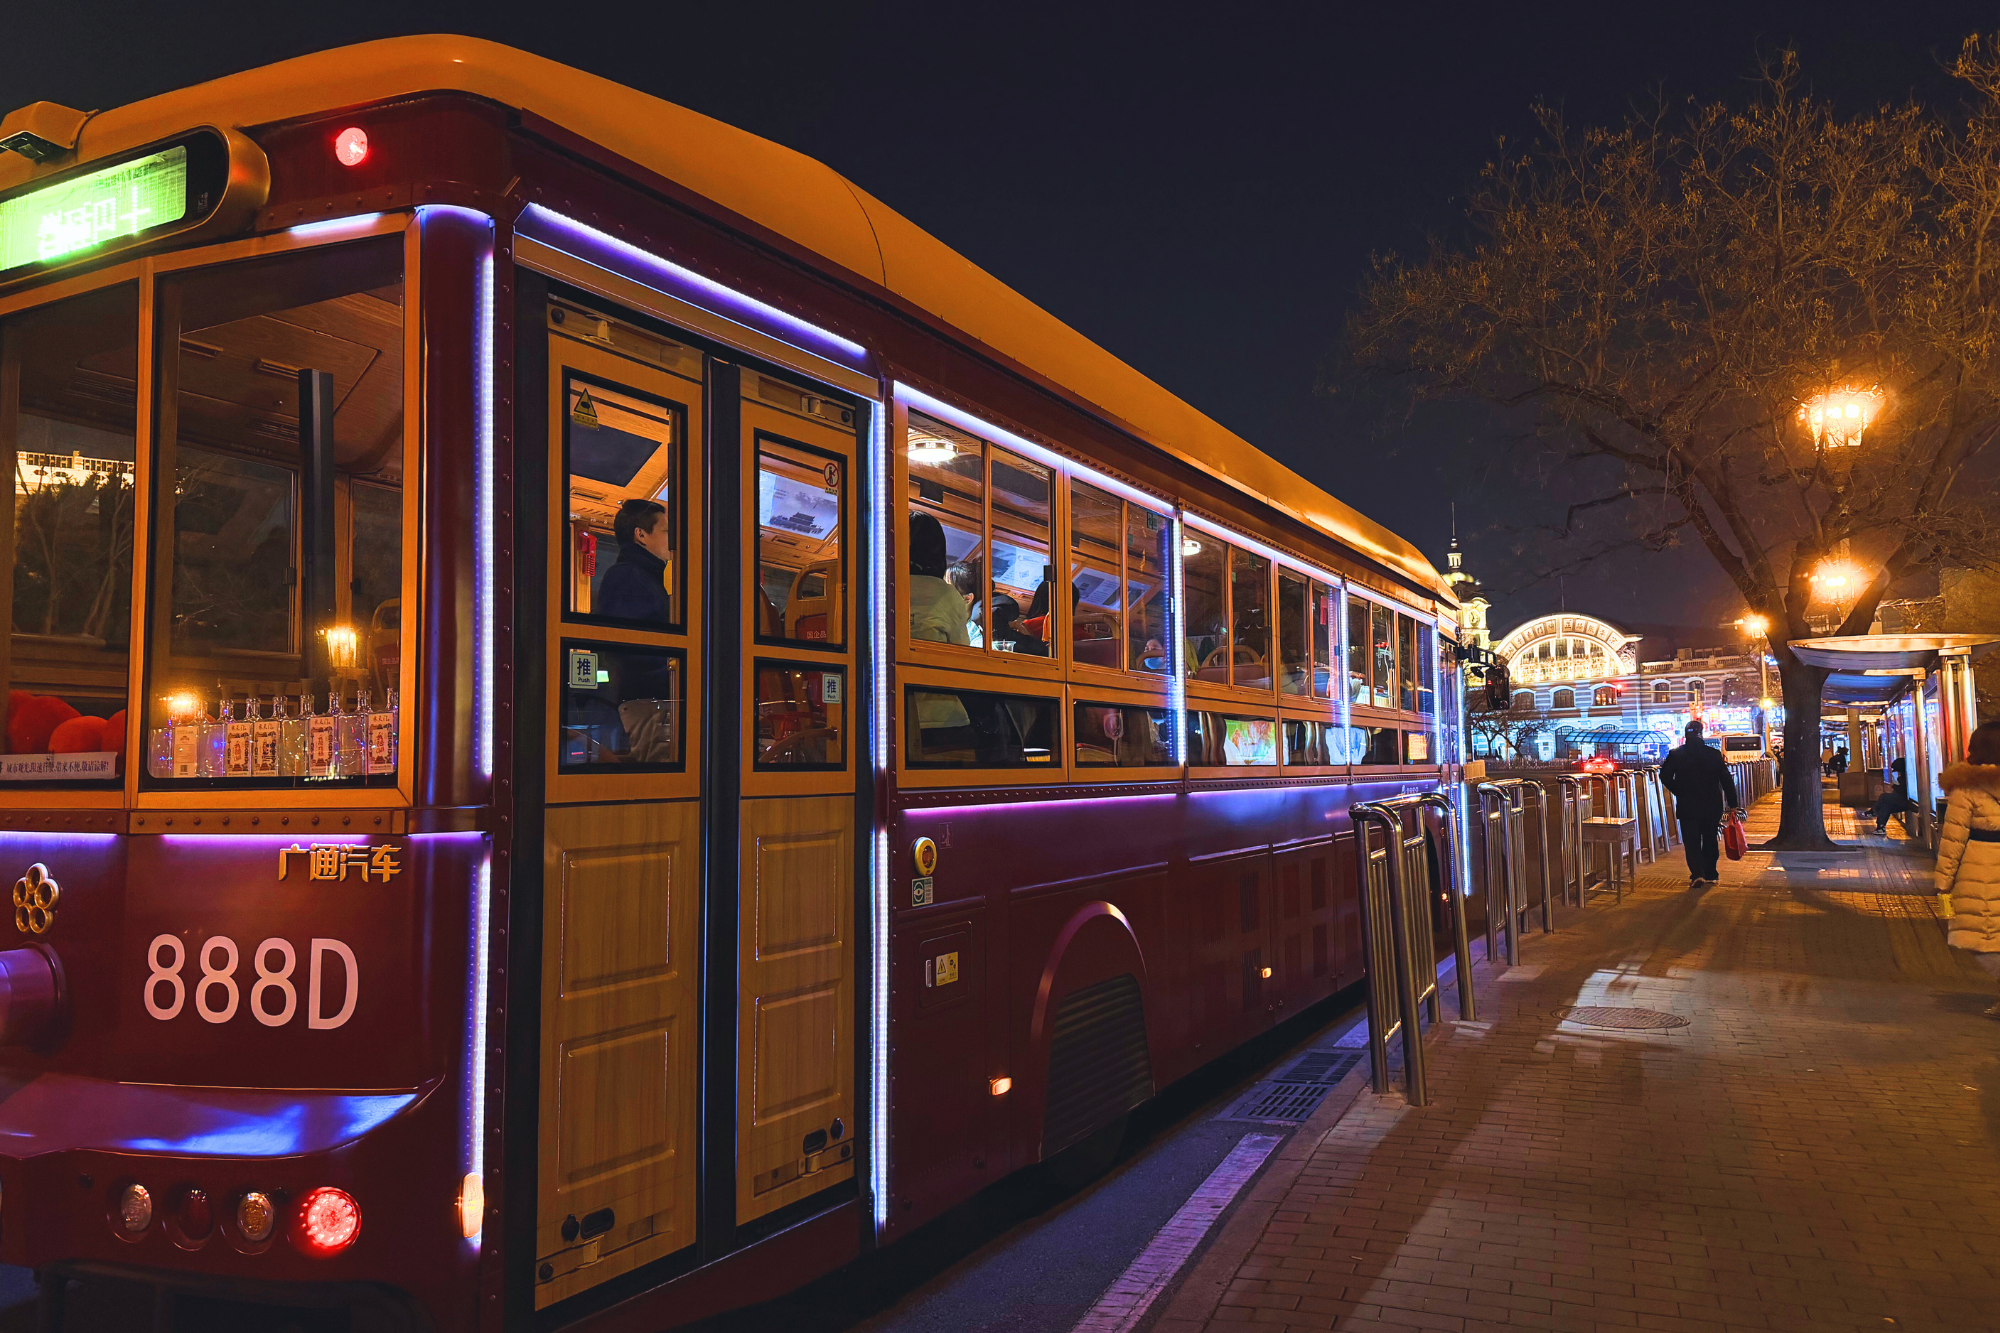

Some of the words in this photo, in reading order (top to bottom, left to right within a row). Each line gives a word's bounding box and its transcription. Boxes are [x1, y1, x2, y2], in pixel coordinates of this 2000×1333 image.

[577, 657, 591, 676] 推
[827, 679, 837, 694] 推
[279, 843, 402, 883] 广通汽车
[144, 933, 358, 1030] 888D
